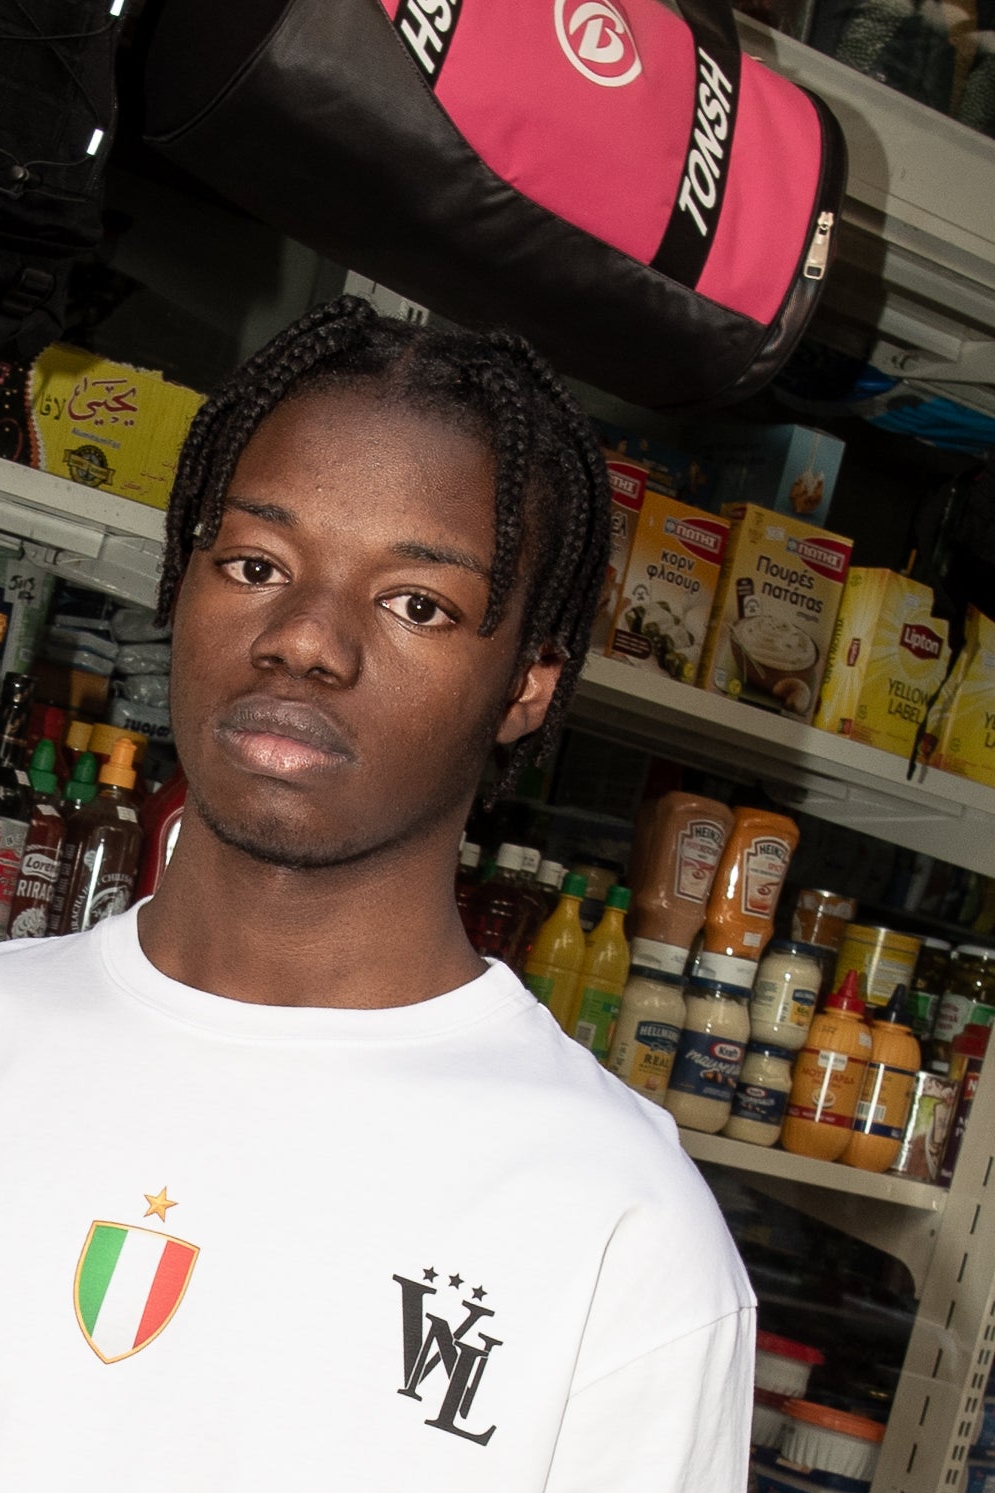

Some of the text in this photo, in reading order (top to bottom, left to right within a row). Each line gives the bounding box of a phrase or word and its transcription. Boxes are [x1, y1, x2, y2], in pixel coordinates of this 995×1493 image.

[678, 47, 732, 236] TONSH
[903, 626, 940, 656] Lipton
[887, 700, 924, 725] LABEL
